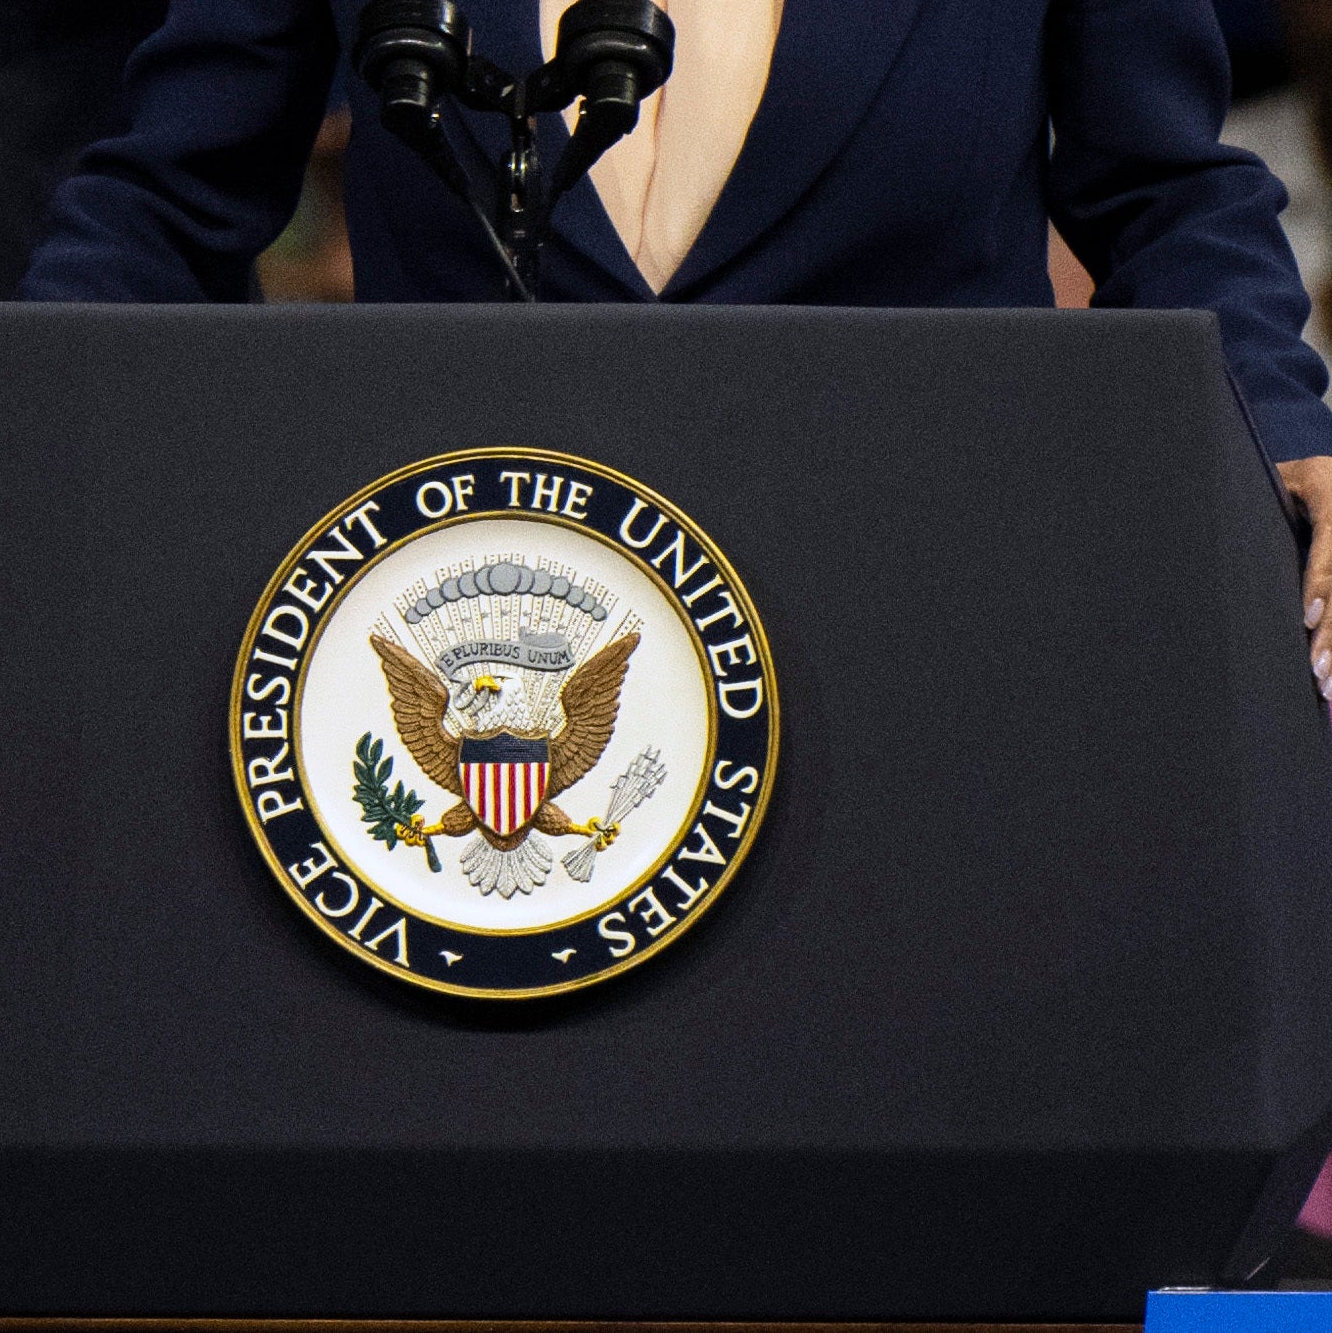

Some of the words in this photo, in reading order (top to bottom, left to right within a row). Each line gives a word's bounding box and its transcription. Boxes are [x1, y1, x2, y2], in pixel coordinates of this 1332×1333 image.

[415, 474, 476, 519] OF
[499, 471, 594, 520] THE
[243, 499, 388, 825] PRESIDENT
[440, 653, 455, 668] E
[451, 642, 521, 660] PLURIBUS
[528, 649, 571, 666] UNUM
[618, 497, 764, 720] UNITED
[288, 840, 410, 968] VICE
[597, 759, 760, 958] STATES
